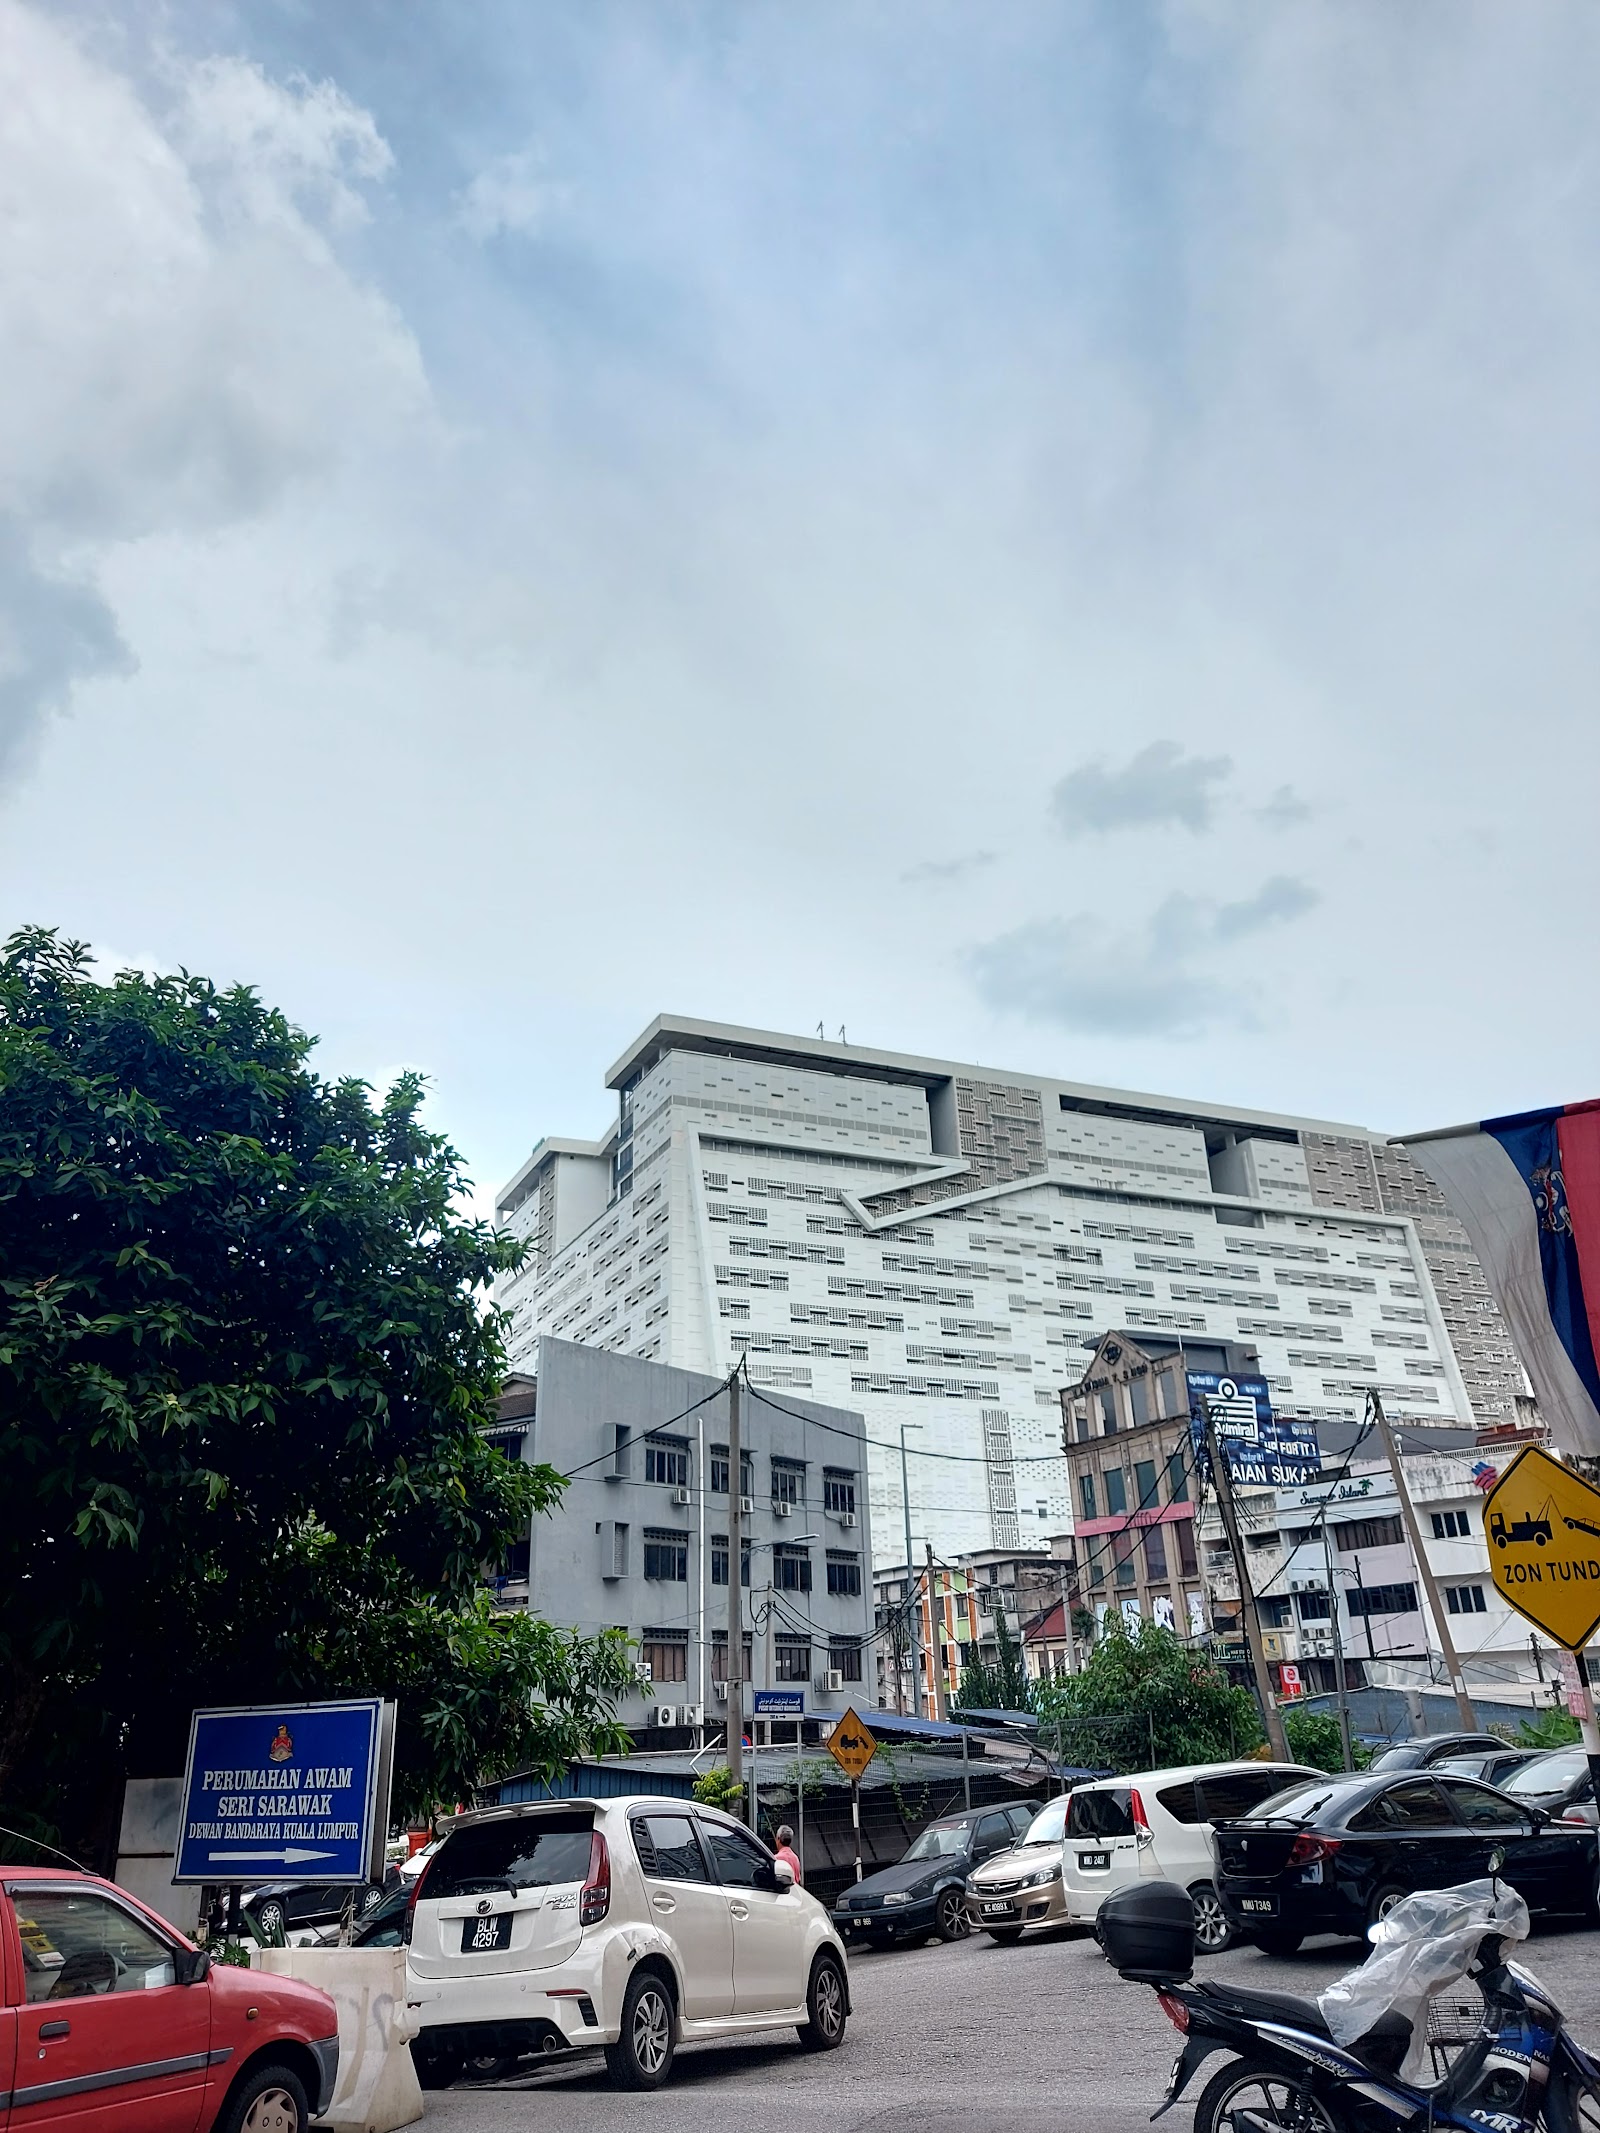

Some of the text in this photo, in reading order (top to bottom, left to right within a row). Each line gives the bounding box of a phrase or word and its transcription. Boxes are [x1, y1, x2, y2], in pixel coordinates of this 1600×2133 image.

[1503, 1563, 1543, 1584] ZON
[202, 1767, 353, 1791] PERUMAHAN AWAM
[217, 1794, 333, 1817] SERI SARAWAK
[188, 1822, 359, 1839] DEWAN BANDARAYA KUALA LUMPUR
[1254, 1900, 1272, 1911] 7349
[477, 1917, 498, 1933] BLW
[472, 1931, 499, 1948] 4297
